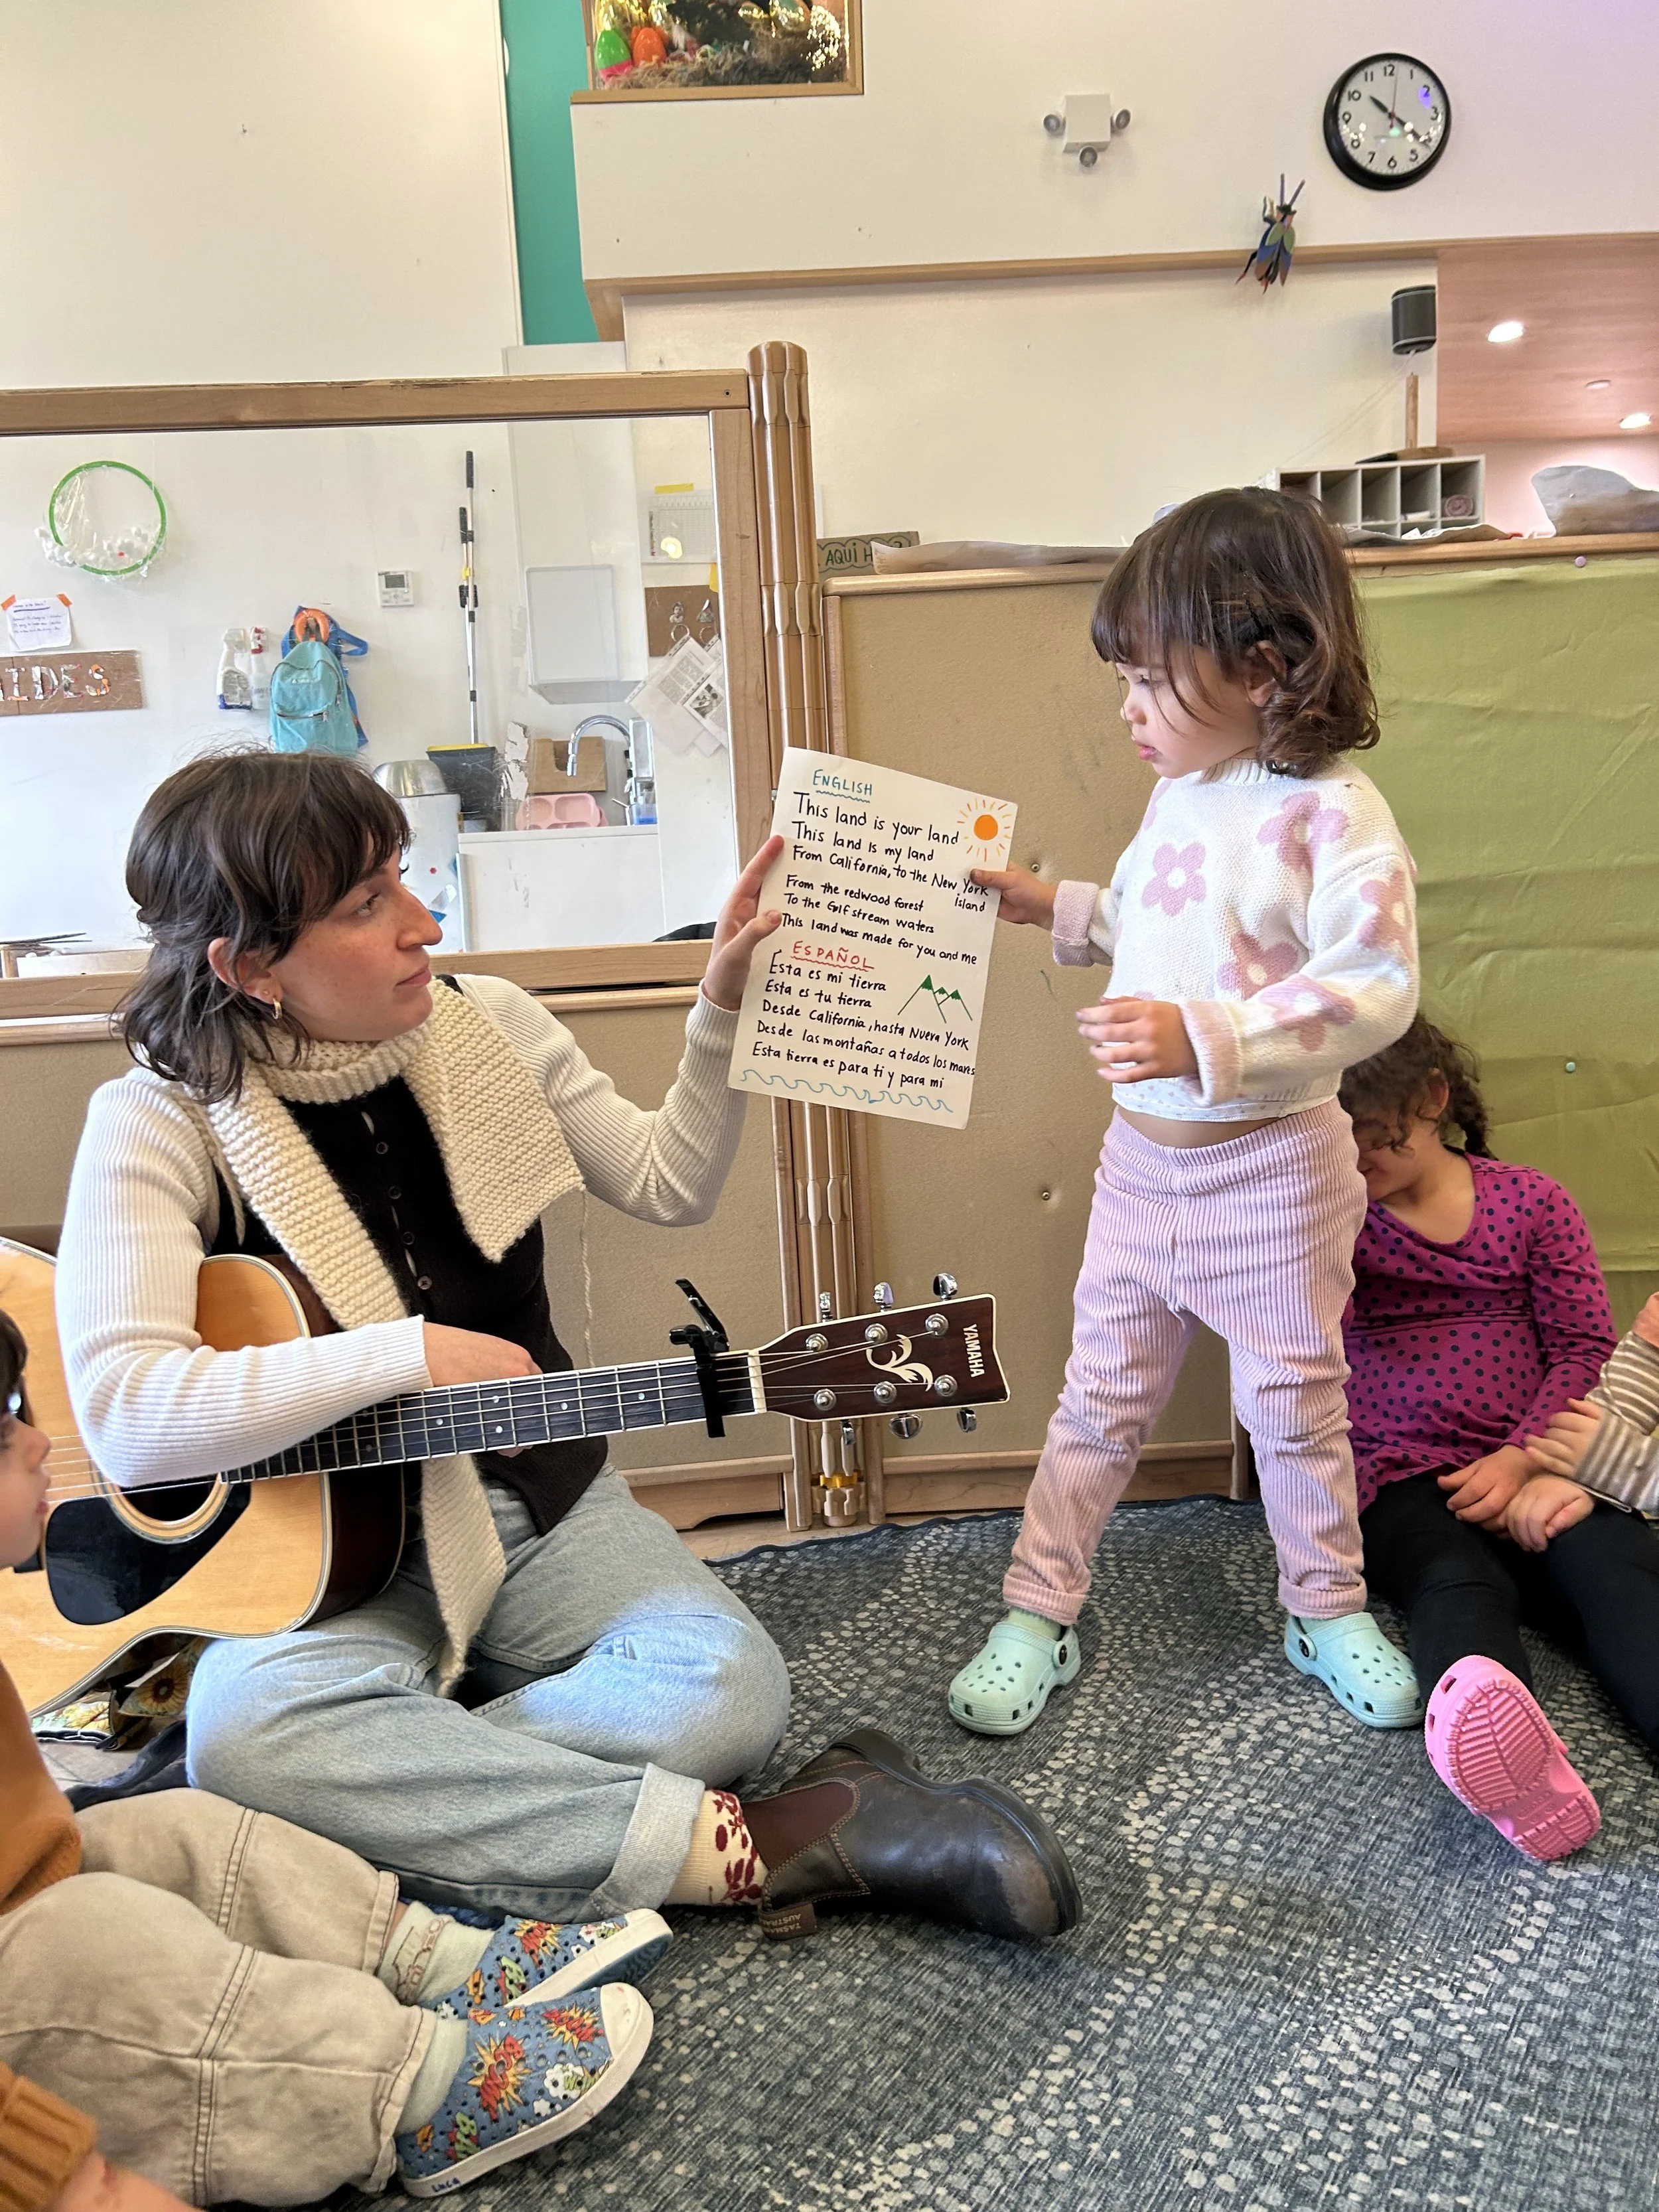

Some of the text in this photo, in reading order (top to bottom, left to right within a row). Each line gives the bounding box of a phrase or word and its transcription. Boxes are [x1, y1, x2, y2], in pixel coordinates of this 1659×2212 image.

[1364, 71, 1374, 82] 11
[1384, 64, 1395, 76] 12
[1410, 69, 1414, 80] 1
[1348, 90, 1361, 101] 10
[1422, 85, 1430, 98] 2
[1342, 111, 1352, 124] 9
[1431, 106, 1439, 120] 3
[1368, 151, 1376, 163] 7
[1388, 156, 1398, 169] 6
[1409, 149, 1418, 162] 5
[0, 664, 111, 701] IDES
[813, 769, 872, 796] ENGLISH
[793, 791, 959, 845] This land is your land
[791, 821, 824, 842] This
[833, 831, 861, 850] land
[885, 848, 902, 864] my
[907, 846, 934, 861] land
[793, 844, 989, 897] From California, to the New York
[786, 874, 924, 912] From the redwood forest
[954, 893, 985, 913] island
[784, 893, 934, 933] To the Gulf stream waters
[782, 913, 977, 964] This land was made for you and me
[792, 940, 875, 970] ESPAÑOL
[769, 949, 887, 991] Esta es mi tierra
[765, 979, 872, 1007] Esta es tu tierra
[762, 999, 801, 1017] Desde
[873, 1019, 905, 1036] hasta
[909, 1027, 940, 1042] Nueva
[944, 1031, 969, 1051] York
[757, 1019, 975, 1075] Desde las montañas a todos los mares
[753, 1041, 780, 1059] Esta
[786, 1049, 818, 1065] tierra
[837, 1061, 868, 1075] para
[873, 1064, 885, 1078] ti
[887, 1071, 895, 1088] y
[900, 1074, 925, 1087] para
[930, 1077, 944, 1088] mi
[963, 1324, 985, 1378] YAMAHA
